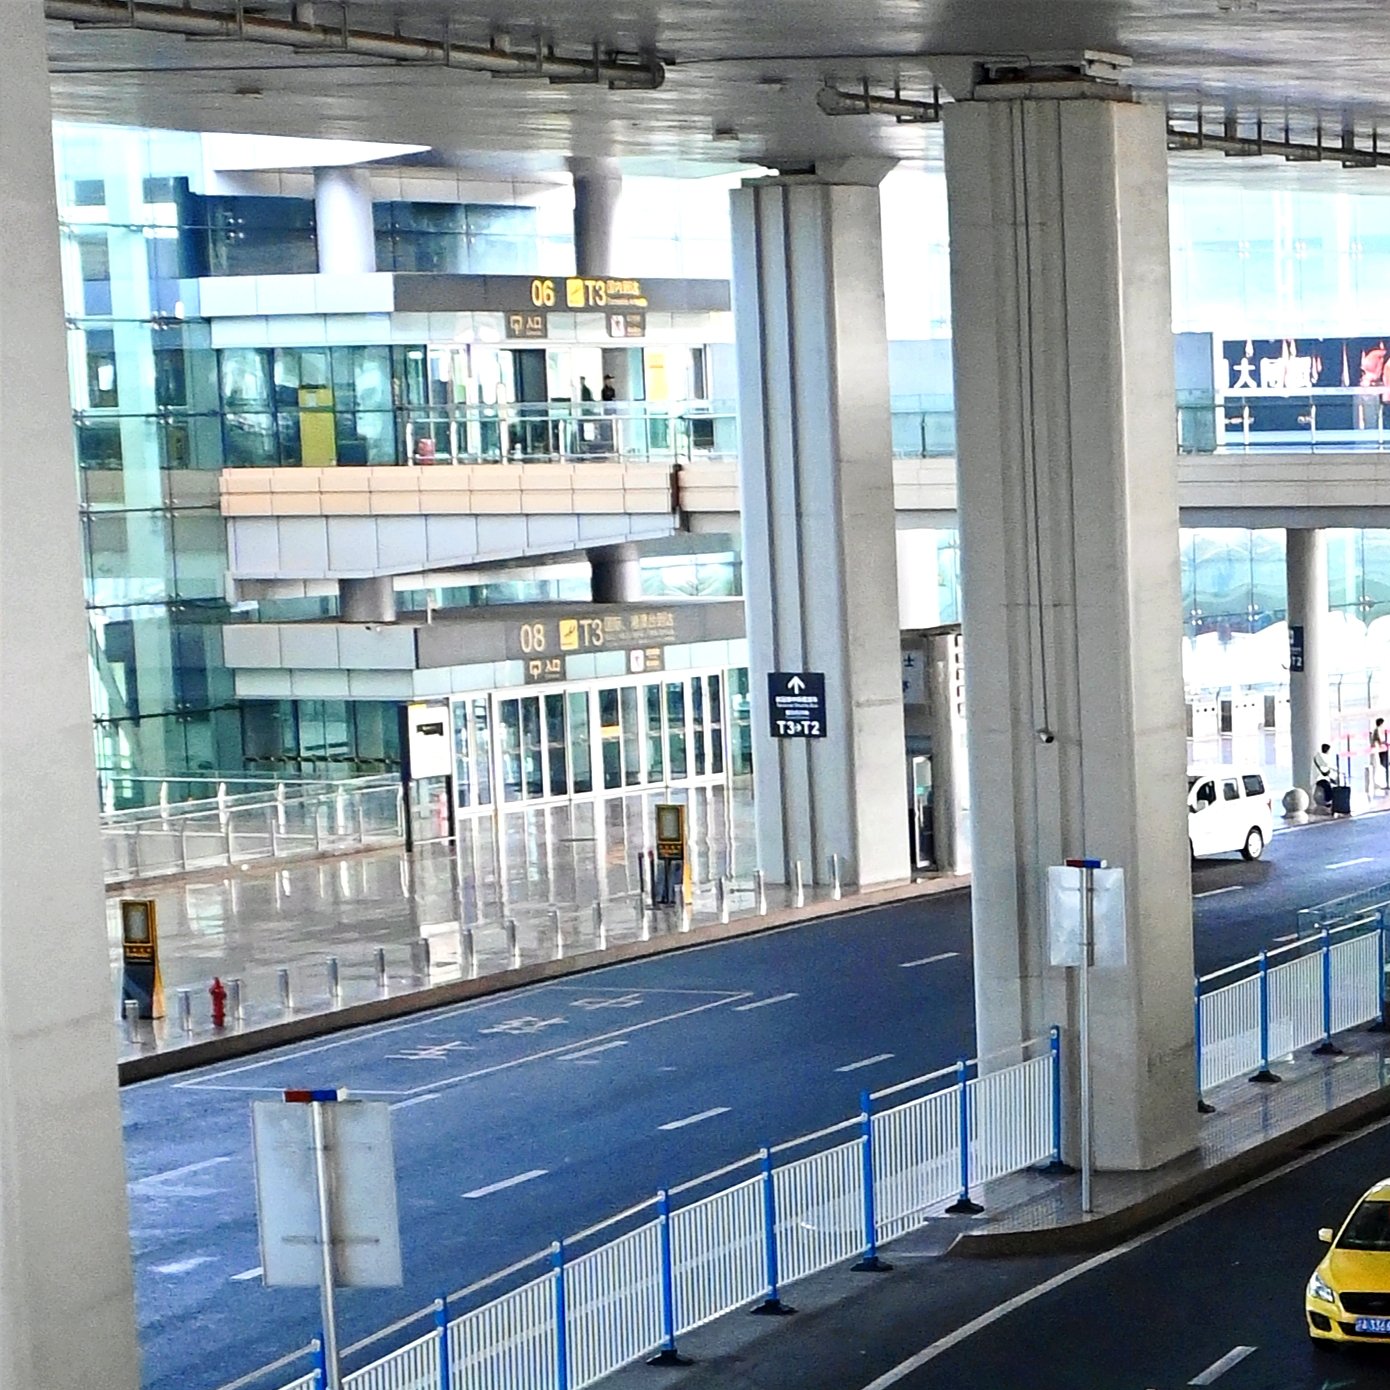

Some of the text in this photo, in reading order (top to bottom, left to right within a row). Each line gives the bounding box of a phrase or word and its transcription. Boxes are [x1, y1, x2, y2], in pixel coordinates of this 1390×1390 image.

[532, 279, 606, 307] 06 T3
[520, 623, 545, 653] 08
[579, 619, 604, 647] T3
